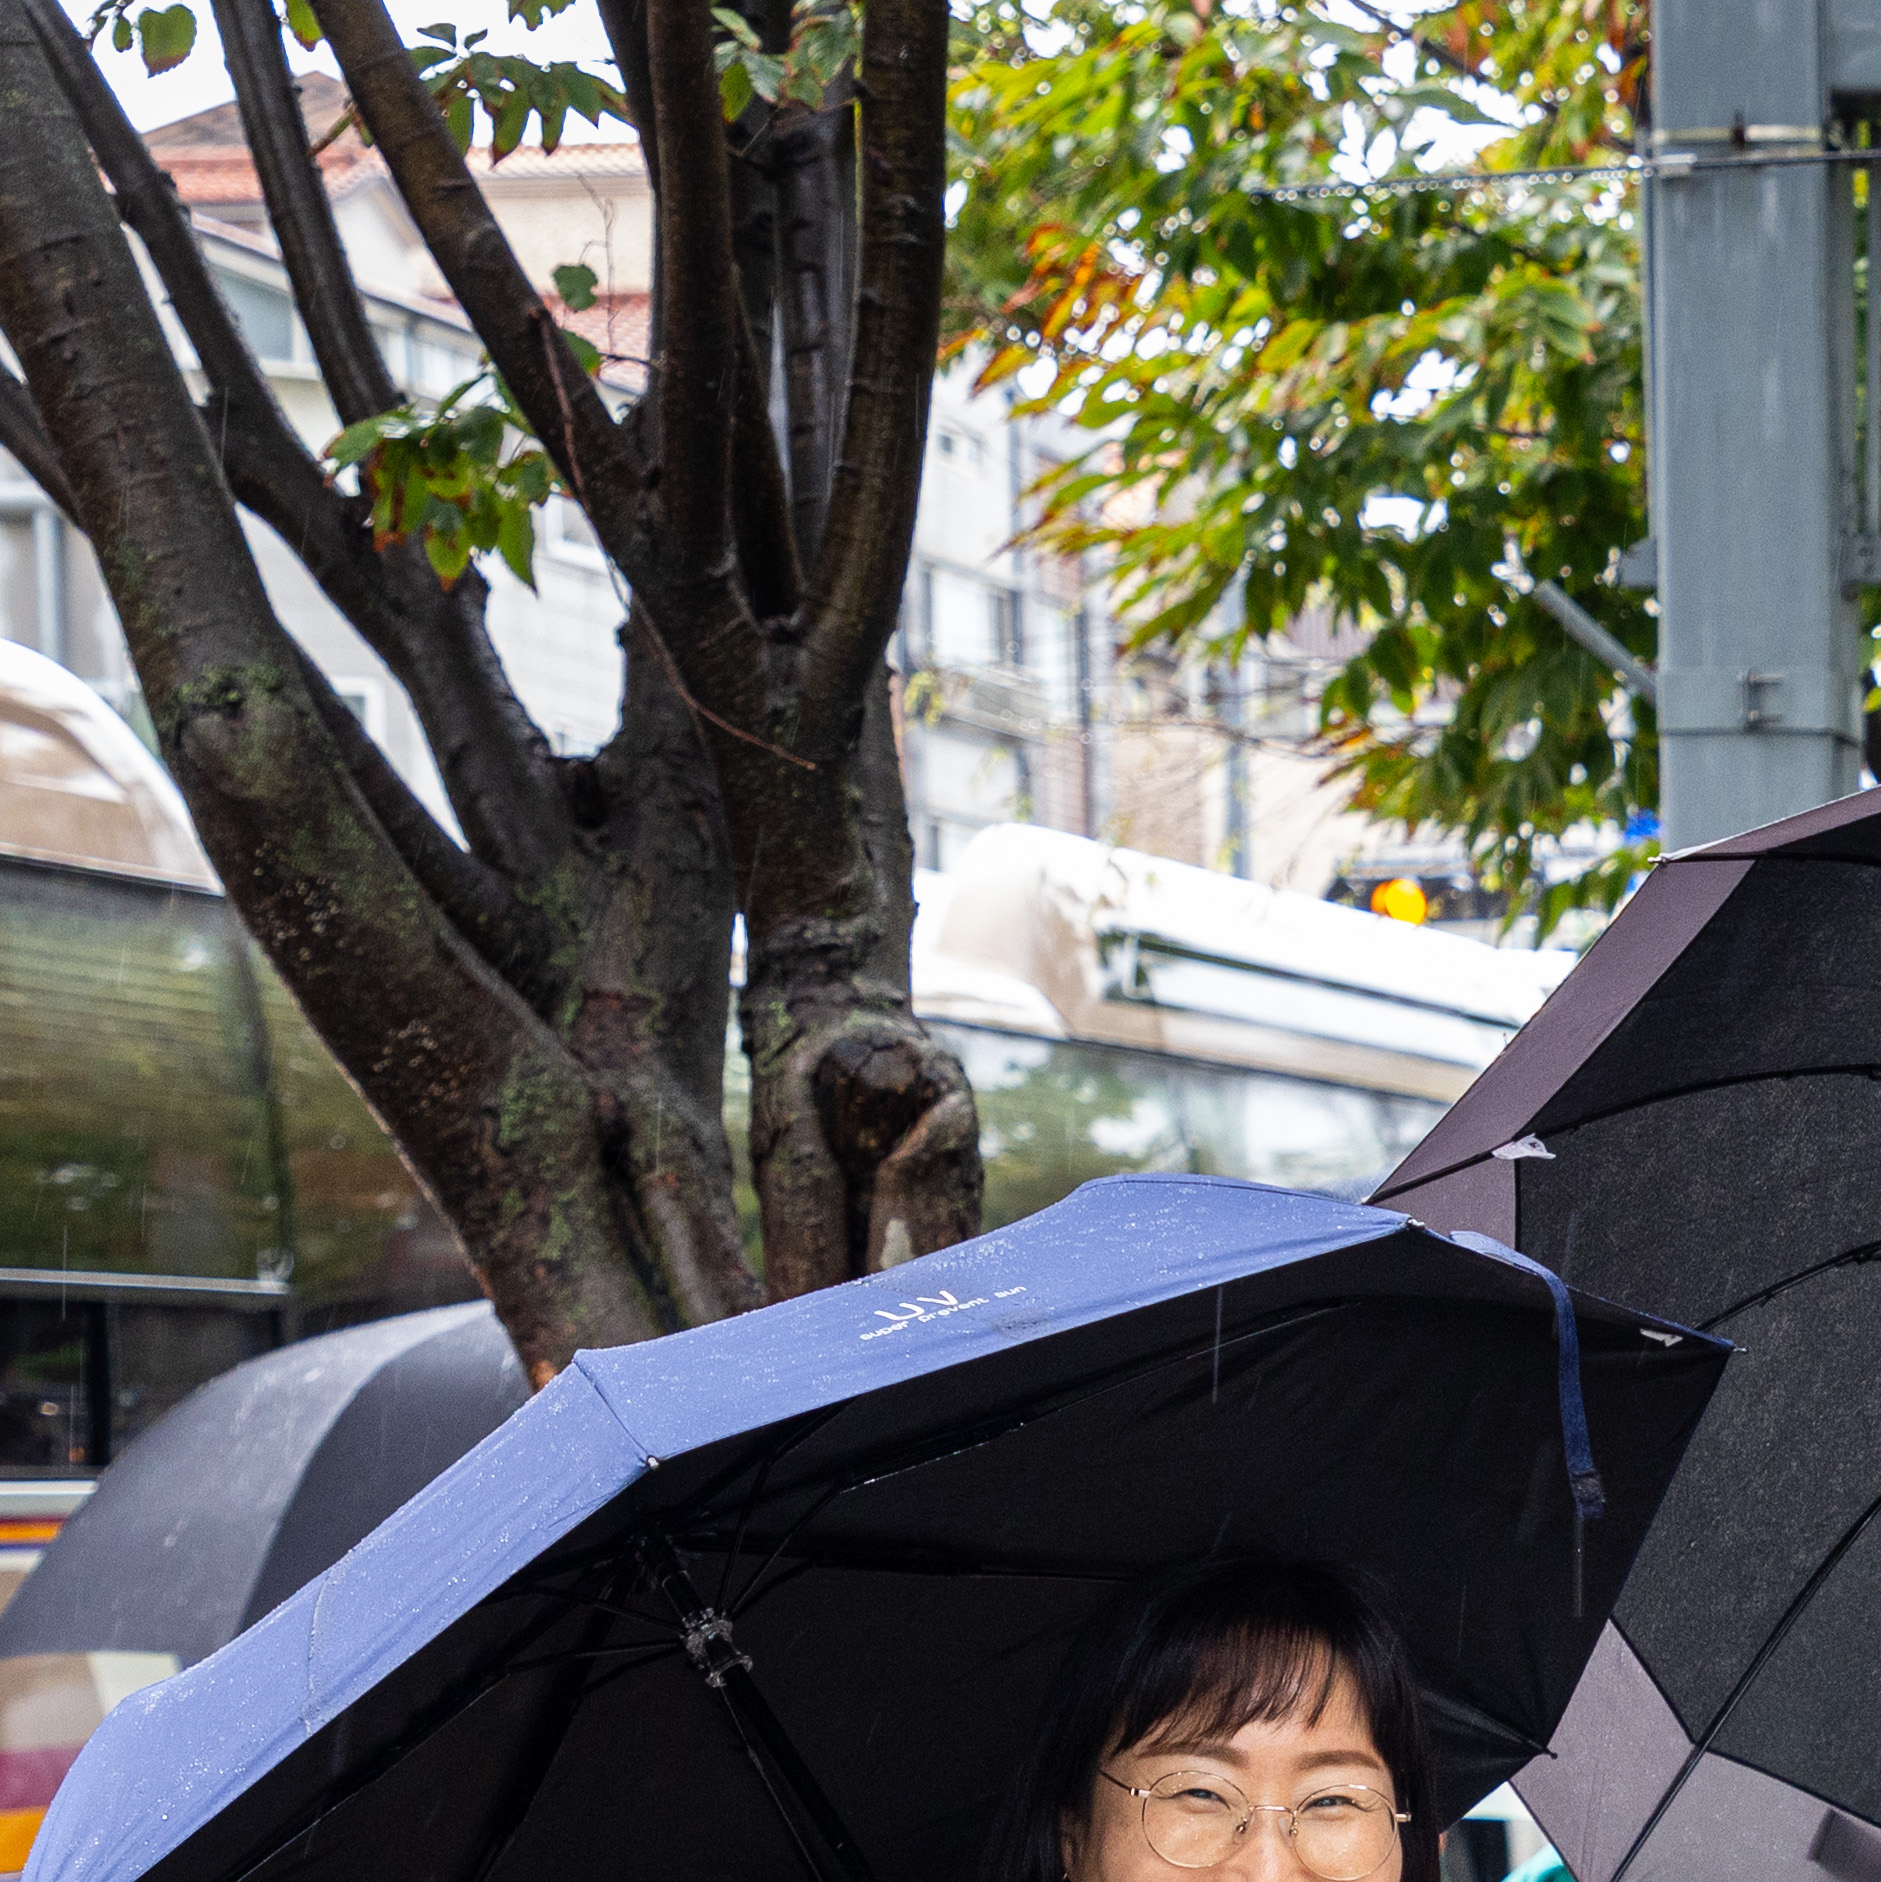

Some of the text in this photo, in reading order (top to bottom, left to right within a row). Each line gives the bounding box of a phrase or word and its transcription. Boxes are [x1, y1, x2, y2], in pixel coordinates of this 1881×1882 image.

[859, 1285, 1027, 1341] super prevent sun
[874, 1290, 959, 1321] UV
